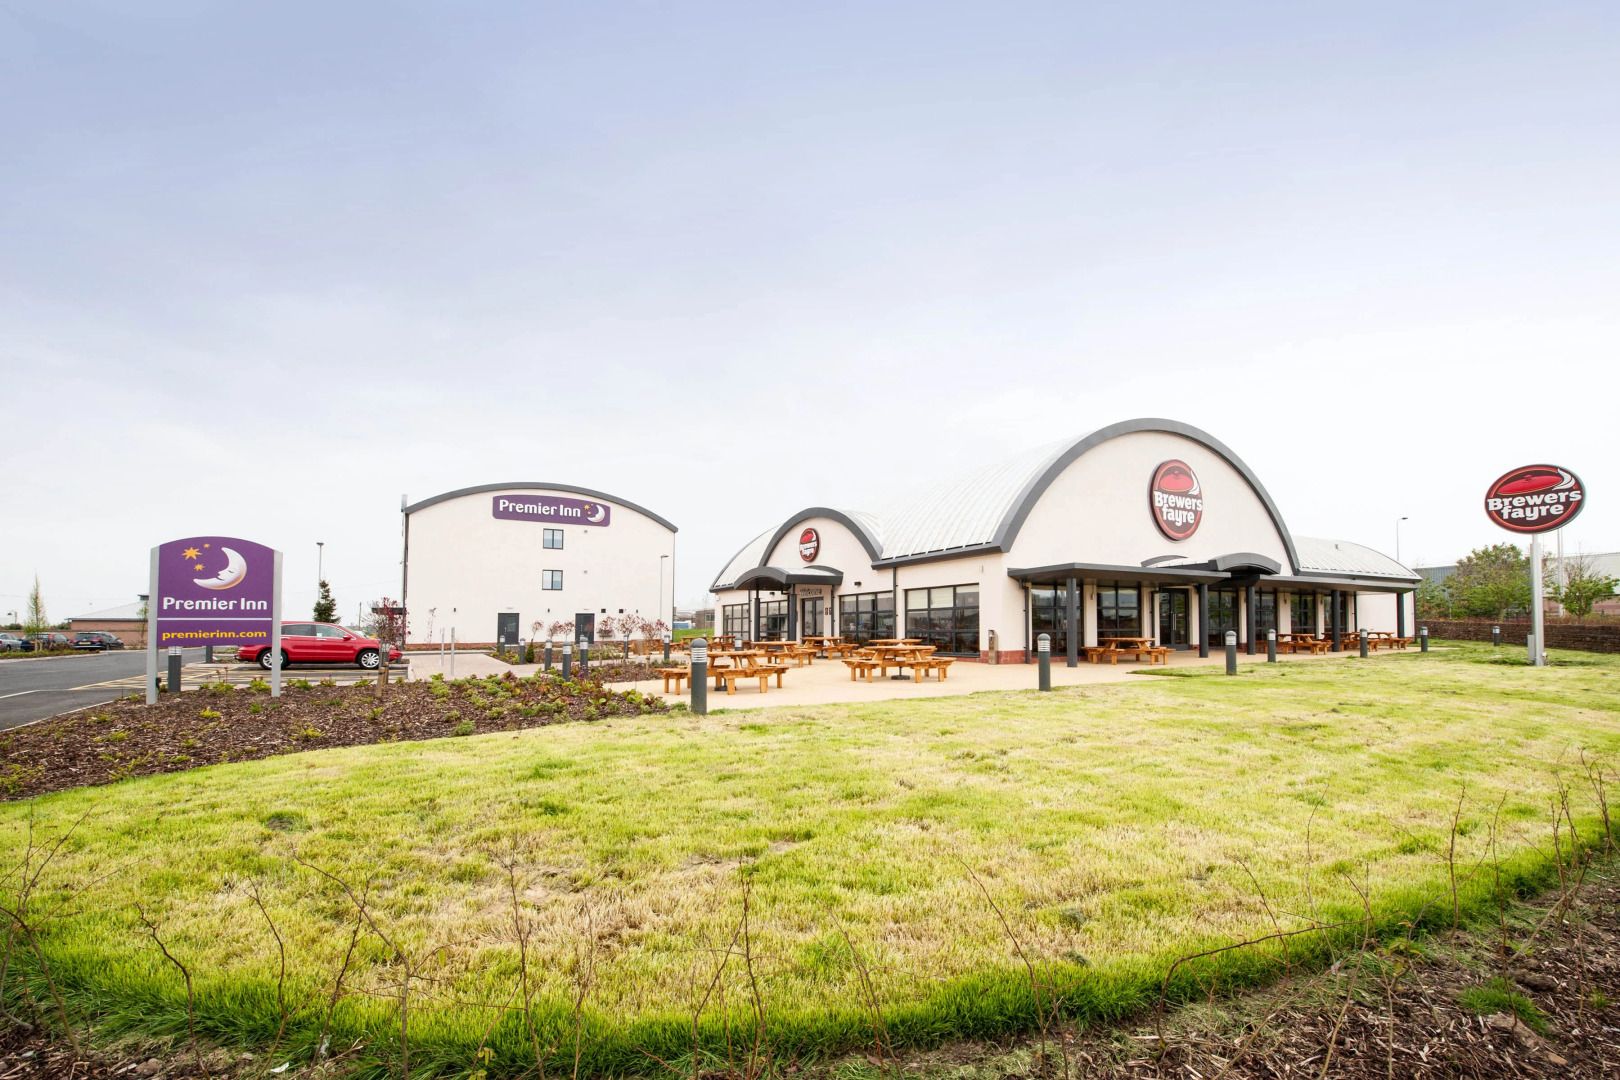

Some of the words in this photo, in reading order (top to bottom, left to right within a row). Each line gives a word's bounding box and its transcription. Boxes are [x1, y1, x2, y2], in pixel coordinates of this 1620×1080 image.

[499, 499, 557, 515] Premier
[559, 504, 581, 517] Inn
[1153, 490, 1203, 511] Brewers
[1487, 490, 1582, 511] Brewers
[1162, 504, 1195, 526] fayre
[1501, 504, 1564, 520] fayre
[162, 597, 238, 610] Premier
[240, 598, 268, 610] Inn
[162, 630, 267, 641] premierinn.com
